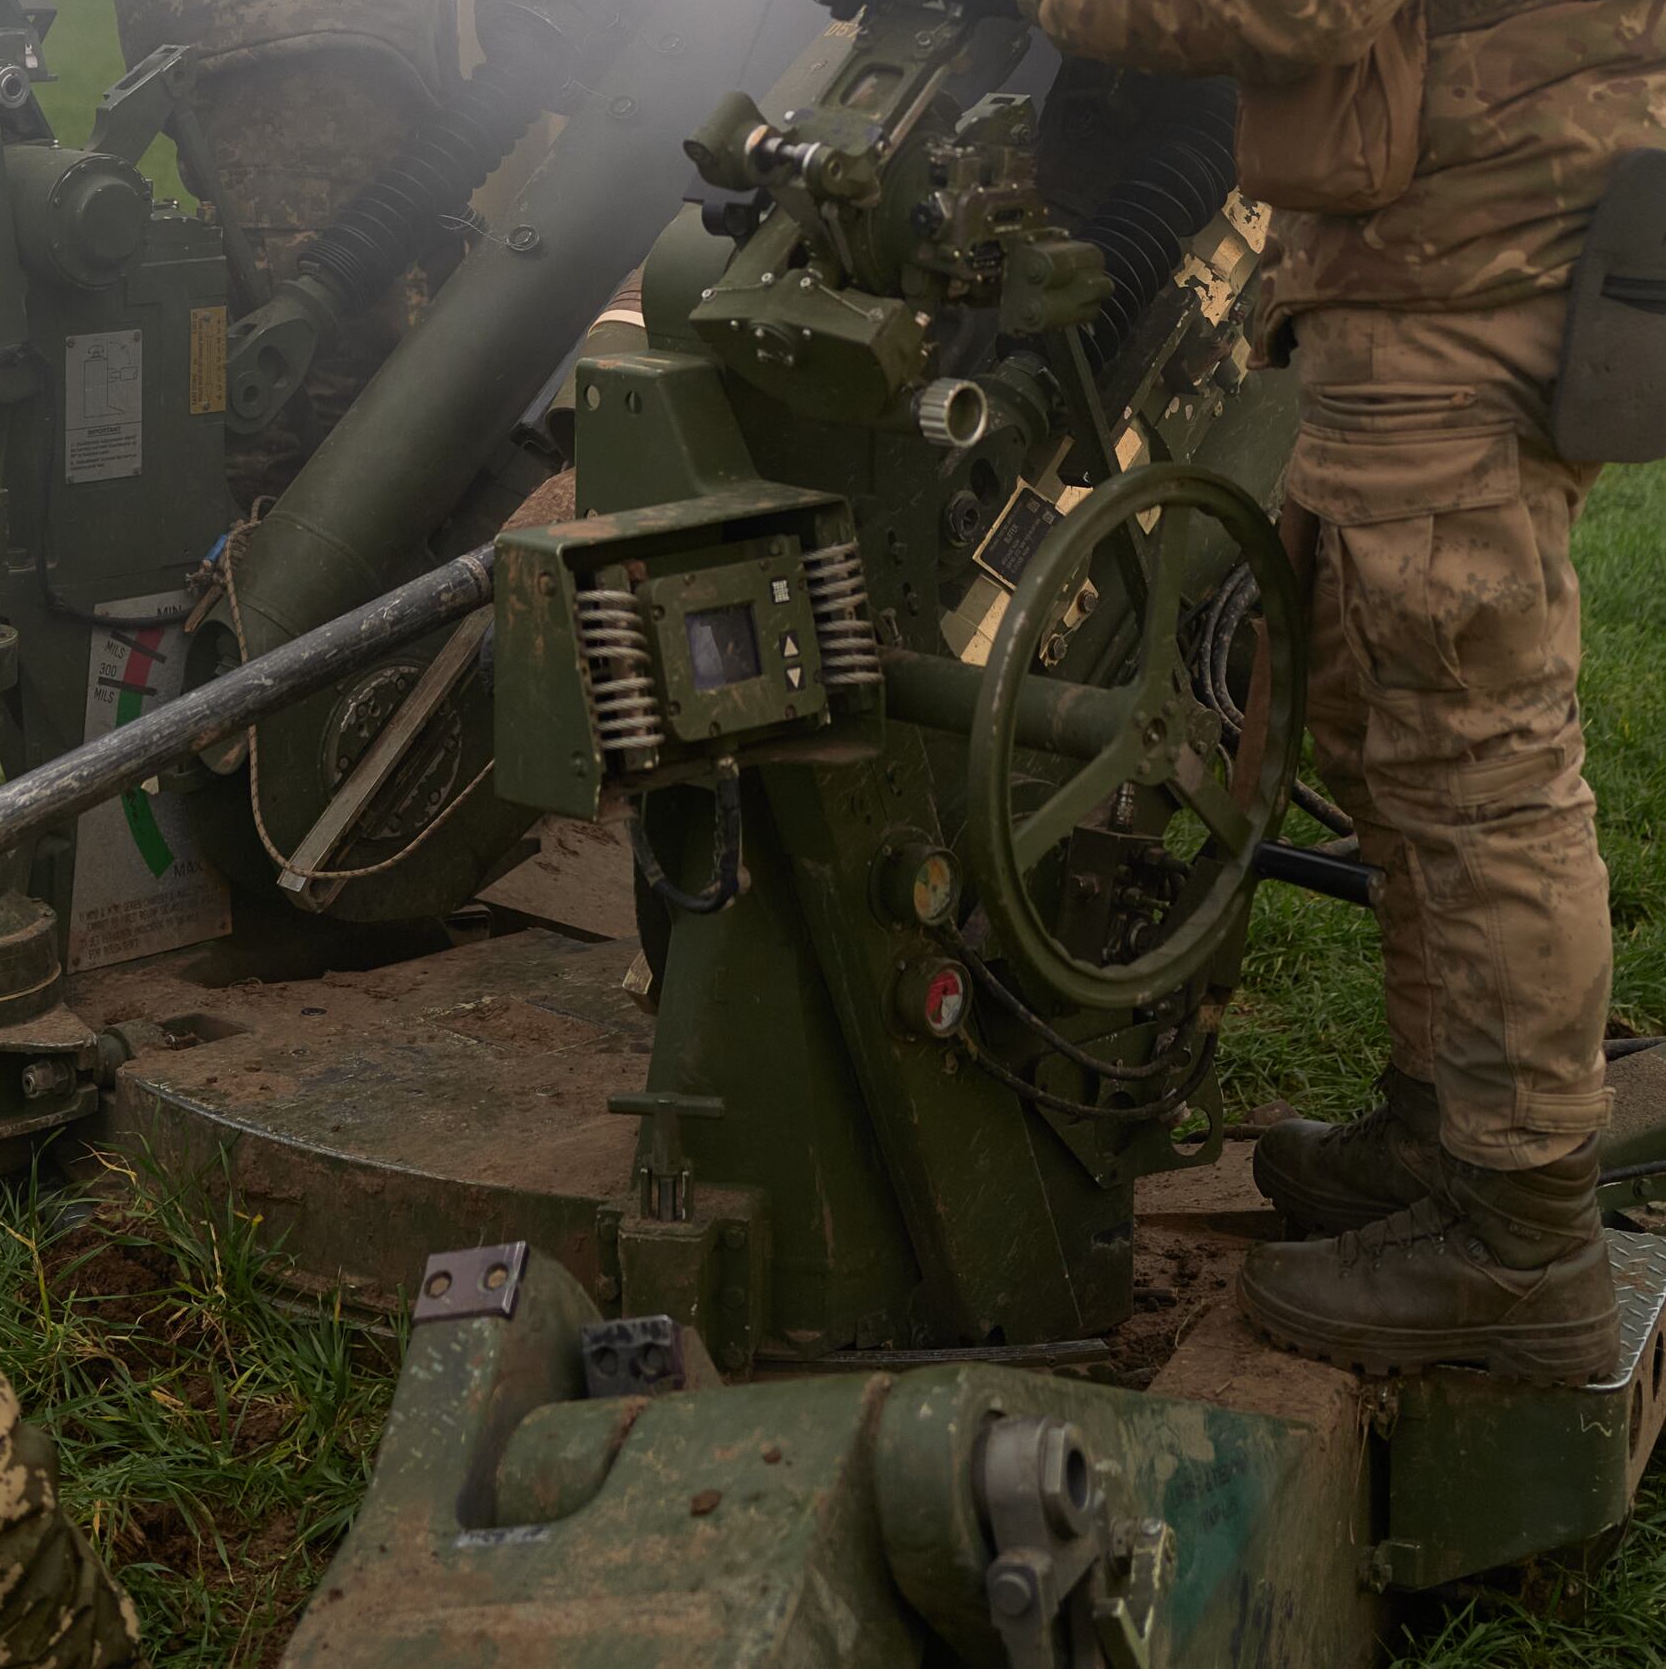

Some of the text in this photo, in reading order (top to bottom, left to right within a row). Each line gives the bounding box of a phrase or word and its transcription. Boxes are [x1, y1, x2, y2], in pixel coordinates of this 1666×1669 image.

[105, 640, 125, 659] MILS
[99, 663, 117, 677] 300
[94, 688, 115, 703] MILS
[174, 861, 204, 877] MAX
